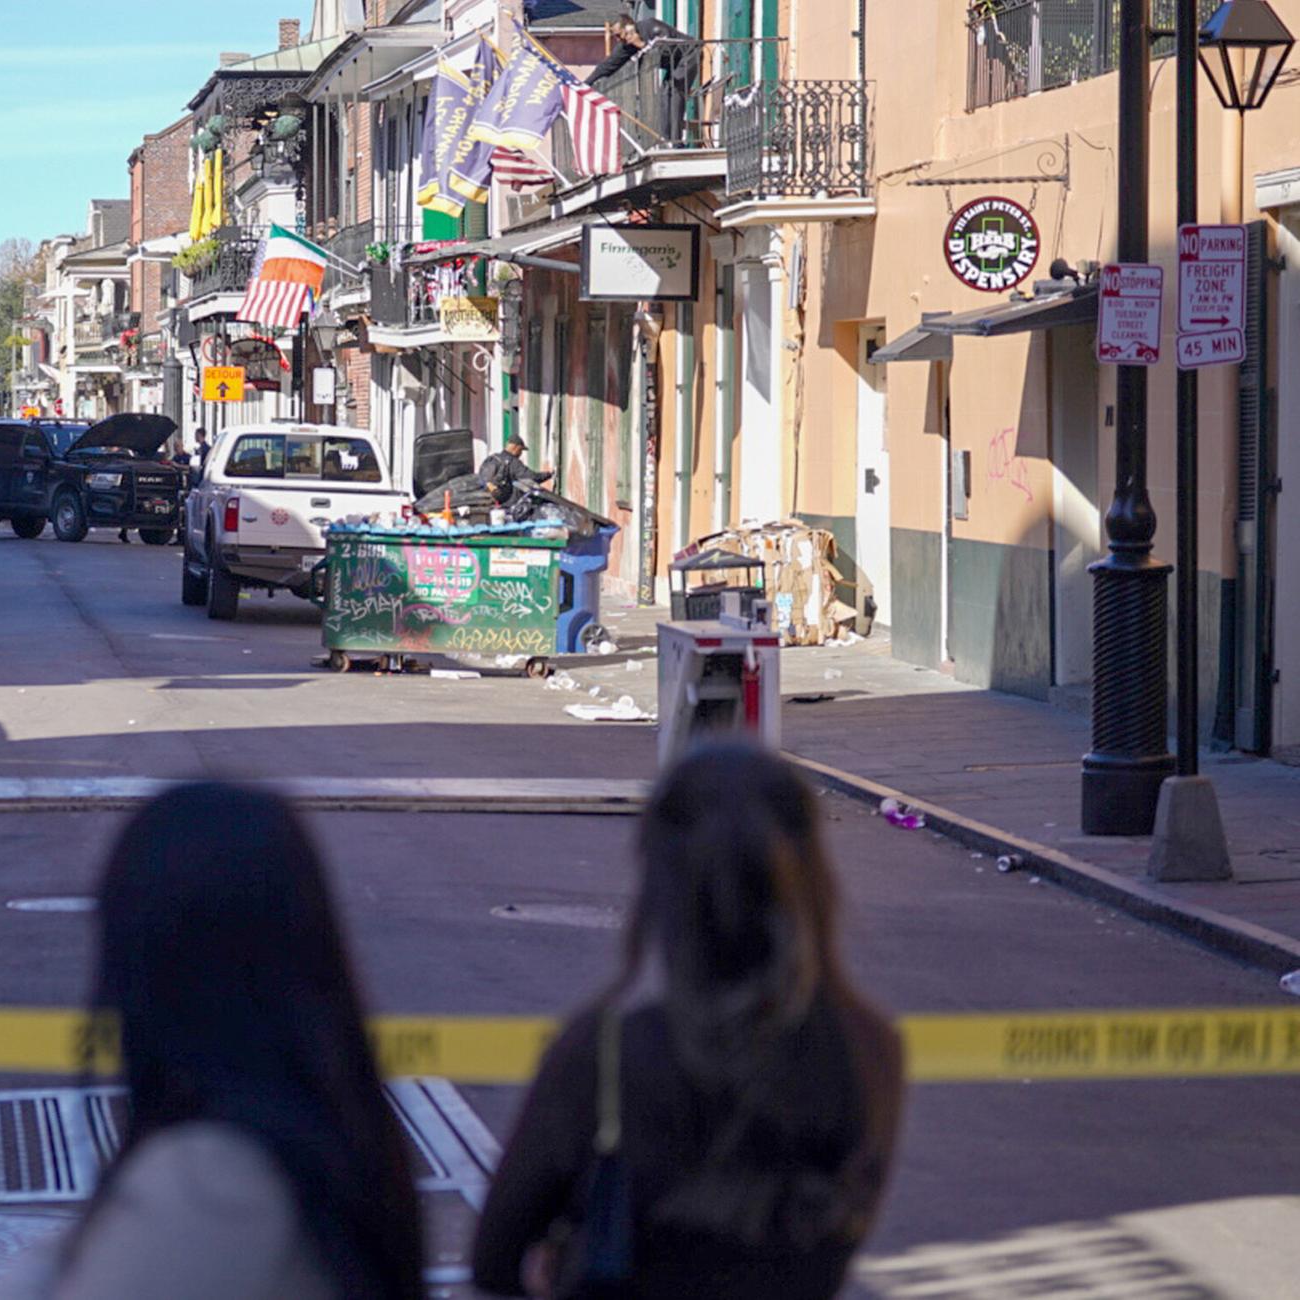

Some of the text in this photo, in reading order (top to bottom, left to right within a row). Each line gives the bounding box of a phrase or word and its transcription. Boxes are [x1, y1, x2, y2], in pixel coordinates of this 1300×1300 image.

[963, 201, 991, 220] SAINT
[992, 201, 1022, 219] PETER
[600, 242, 676, 257] Finnegan's
[1180, 234, 1243, 254] NO PARKING
[948, 237, 1038, 289] DISPENSARY
[1187, 265, 1236, 278] FREIGHT
[1103, 272, 1161, 291] NO STOPPING
[1195, 279, 1227, 293] ZONE
[1115, 310, 1148, 319] TUESDAY
[1117, 321, 1144, 329] STREET
[1111, 331, 1149, 340] CLEANING
[1184, 336, 1238, 357] 45 MIN
[205, 369, 242, 380] DETOUR
